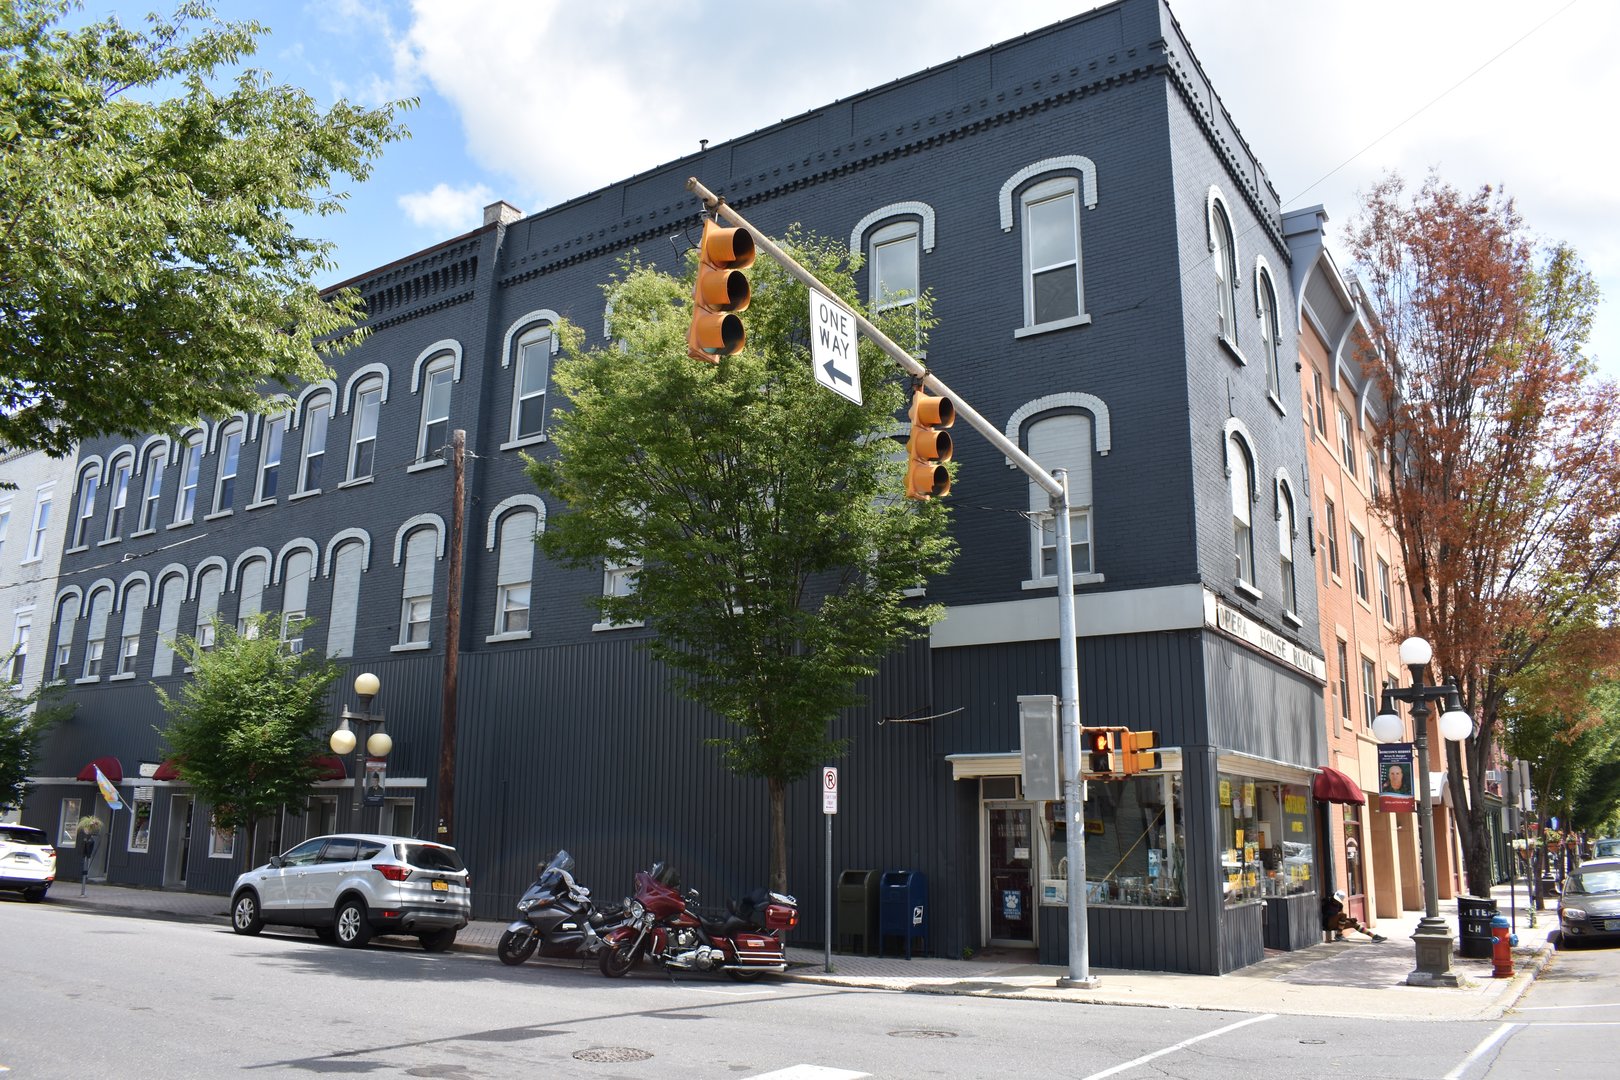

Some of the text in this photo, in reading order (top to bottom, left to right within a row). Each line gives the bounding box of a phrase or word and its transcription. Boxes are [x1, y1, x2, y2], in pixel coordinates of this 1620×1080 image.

[819, 303, 848, 337] ONE
[819, 325, 850, 360] WAY
[1219, 607, 1316, 675] OPERA HOUSE BLOCK
[1468, 923, 1481, 933] LH
